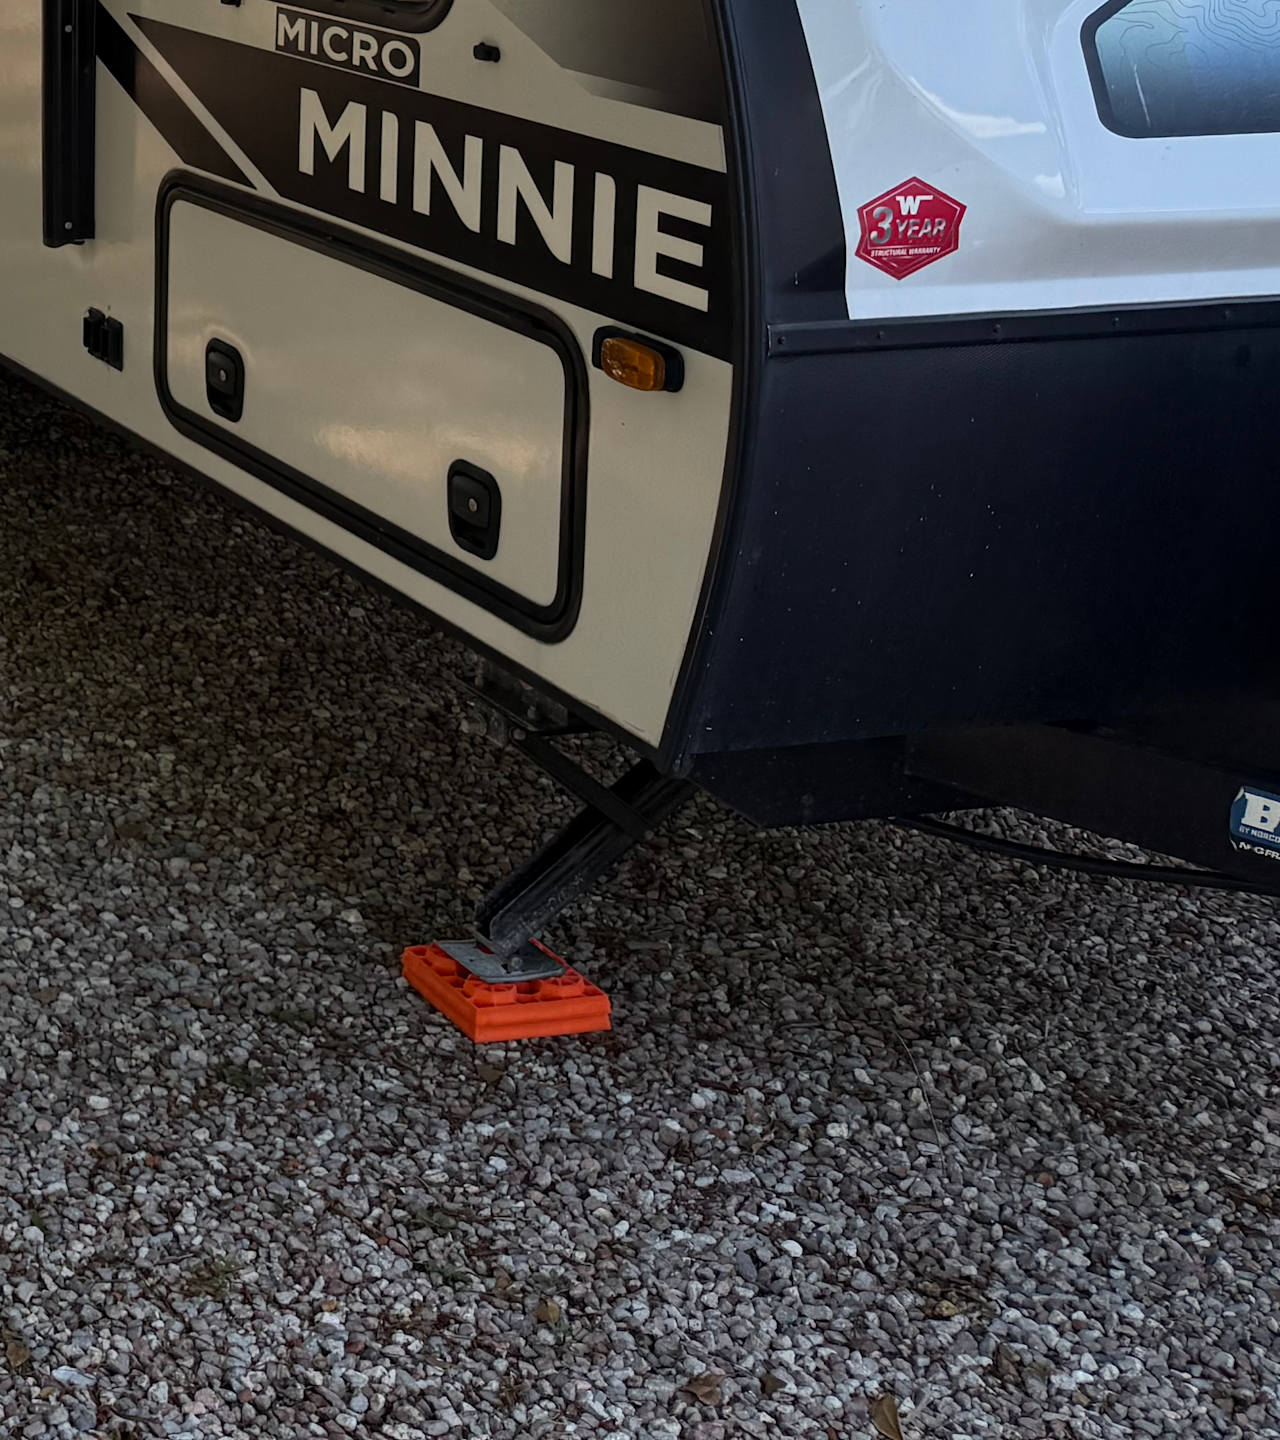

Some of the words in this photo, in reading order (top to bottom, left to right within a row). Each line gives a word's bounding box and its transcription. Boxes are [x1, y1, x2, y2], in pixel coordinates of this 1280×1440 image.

[278, 13, 416, 78] MICRO
[298, 88, 712, 312] MINNIE
[870, 207, 893, 244] 3
[896, 218, 946, 239] YEAR
